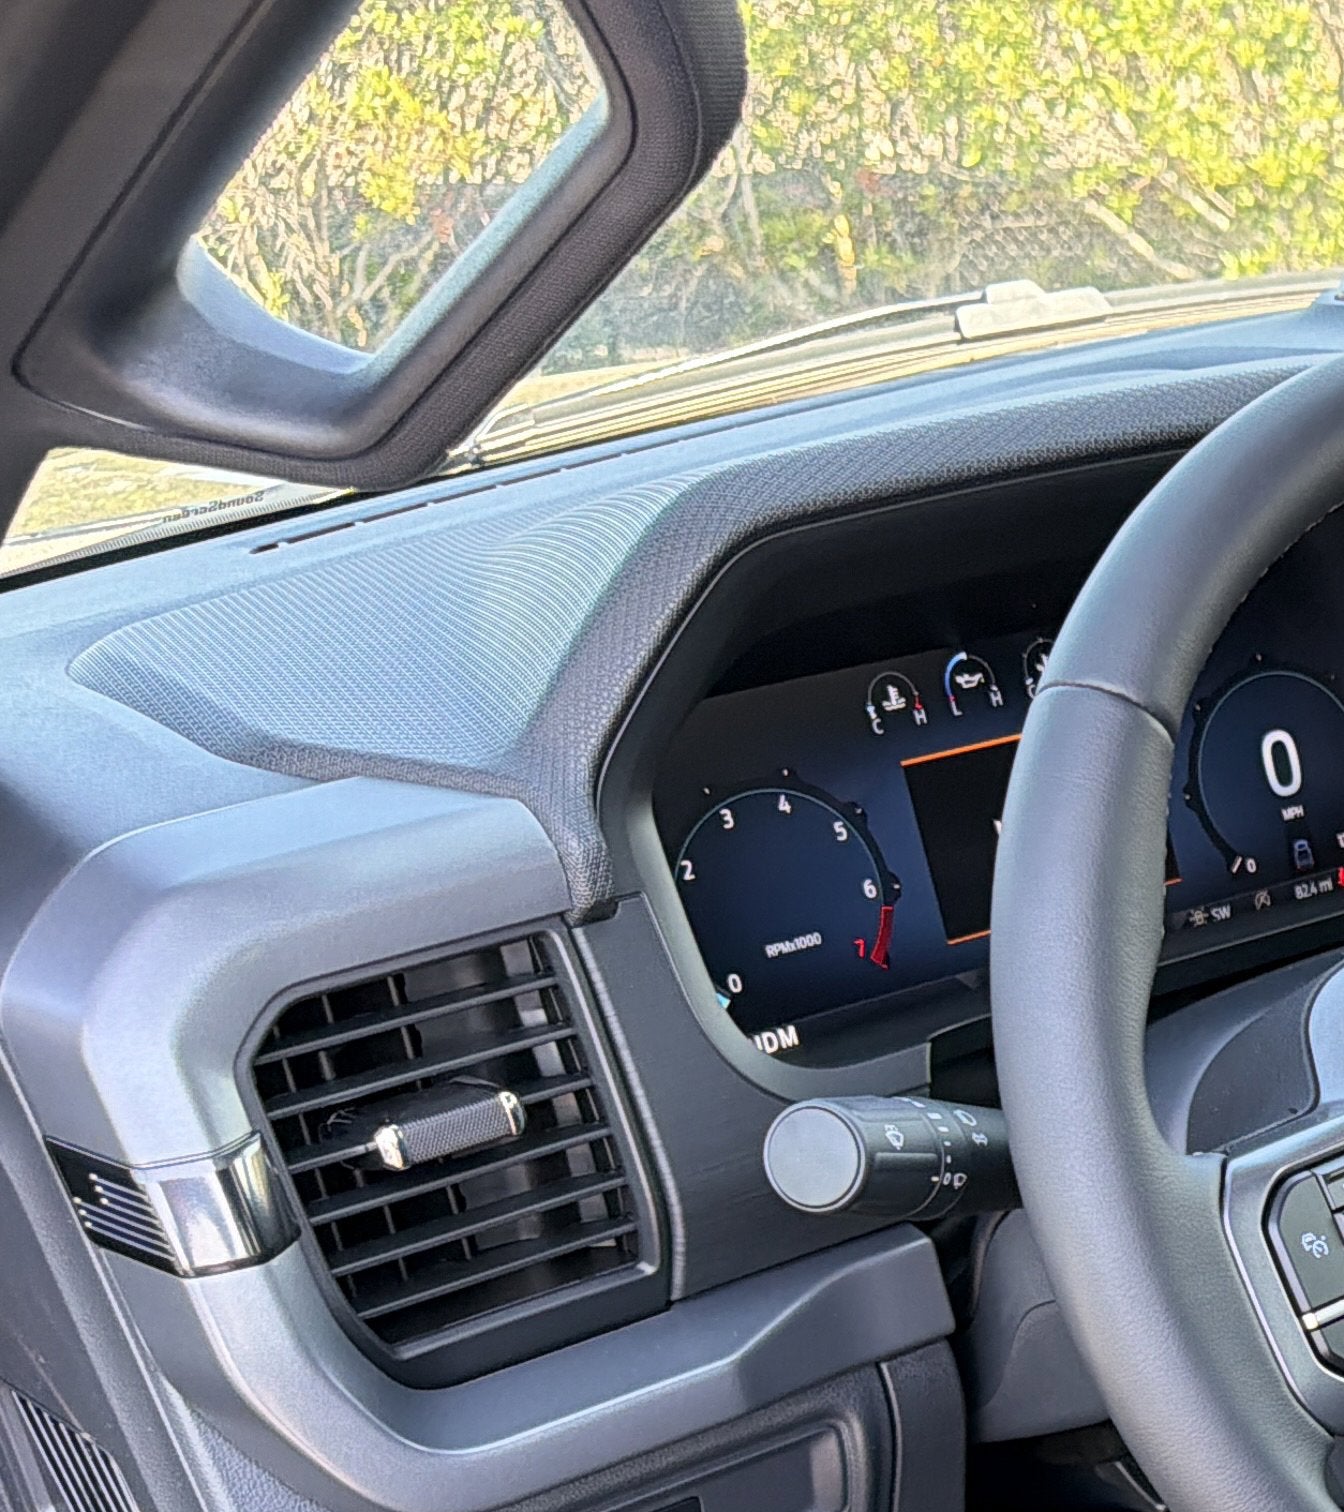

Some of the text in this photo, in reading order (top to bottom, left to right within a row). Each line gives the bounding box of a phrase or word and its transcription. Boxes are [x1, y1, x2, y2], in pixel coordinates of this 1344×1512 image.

[872, 718, 884, 735] C
[913, 709, 928, 725] H
[1260, 729, 1301, 797] 0
[778, 795, 791, 814] 4
[1281, 805, 1304, 821] MPH
[719, 809, 734, 829] 3
[833, 821, 848, 841] 5
[680, 860, 695, 880] 2
[1246, 858, 1257, 873] 0
[863, 879, 878, 899] 6
[1319, 877, 1333, 893] mi
[765, 932, 822, 958] RPMx1000
[853, 938, 865, 958] 7
[727, 973, 742, 993] 0
